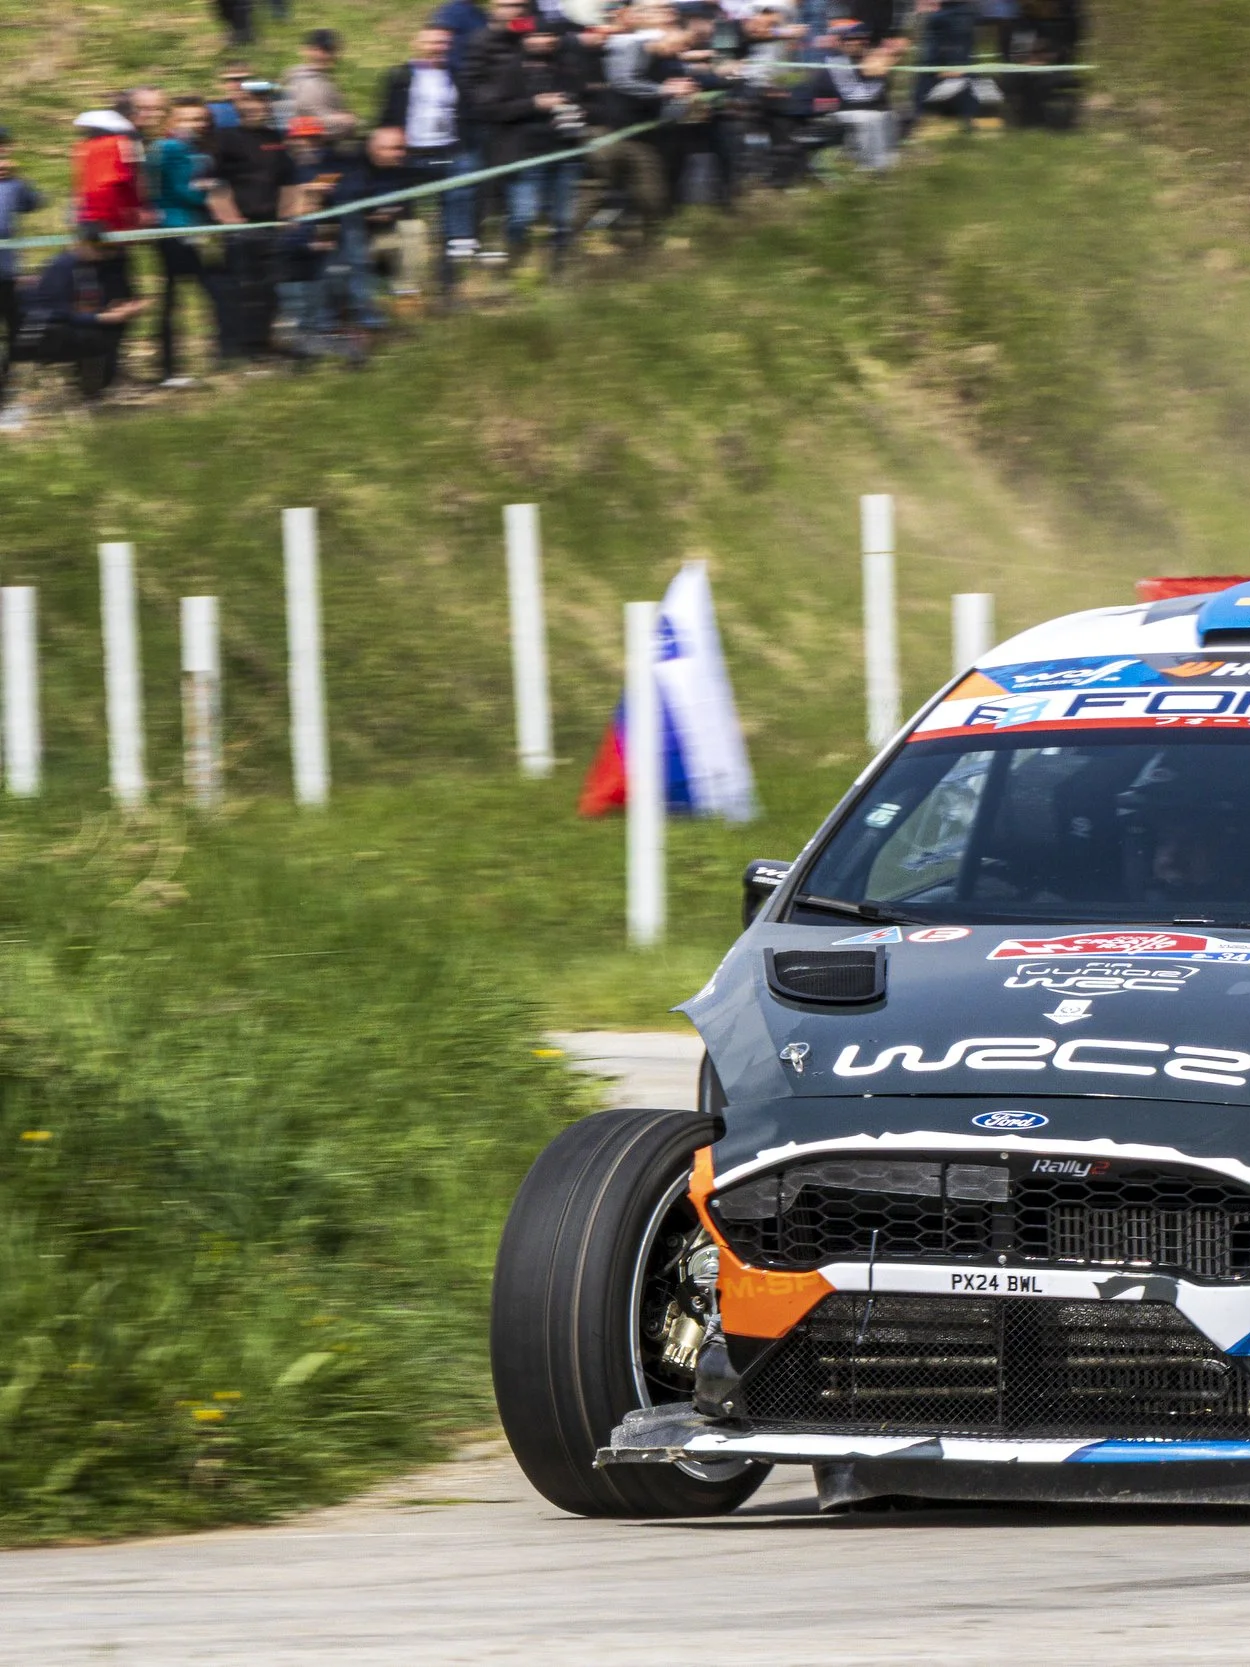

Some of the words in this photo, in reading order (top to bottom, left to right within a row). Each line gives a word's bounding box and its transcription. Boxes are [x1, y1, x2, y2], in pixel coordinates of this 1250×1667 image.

[1217, 952, 1248, 961] 34
[1026, 968, 1182, 978] JUNIOR
[1003, 976, 1186, 992] WRC
[984, 1113, 1036, 1127] Ford
[1032, 1159, 1111, 1177] Rally2
[952, 1274, 999, 1291] PX24
[1007, 1275, 1043, 1293] BWL
